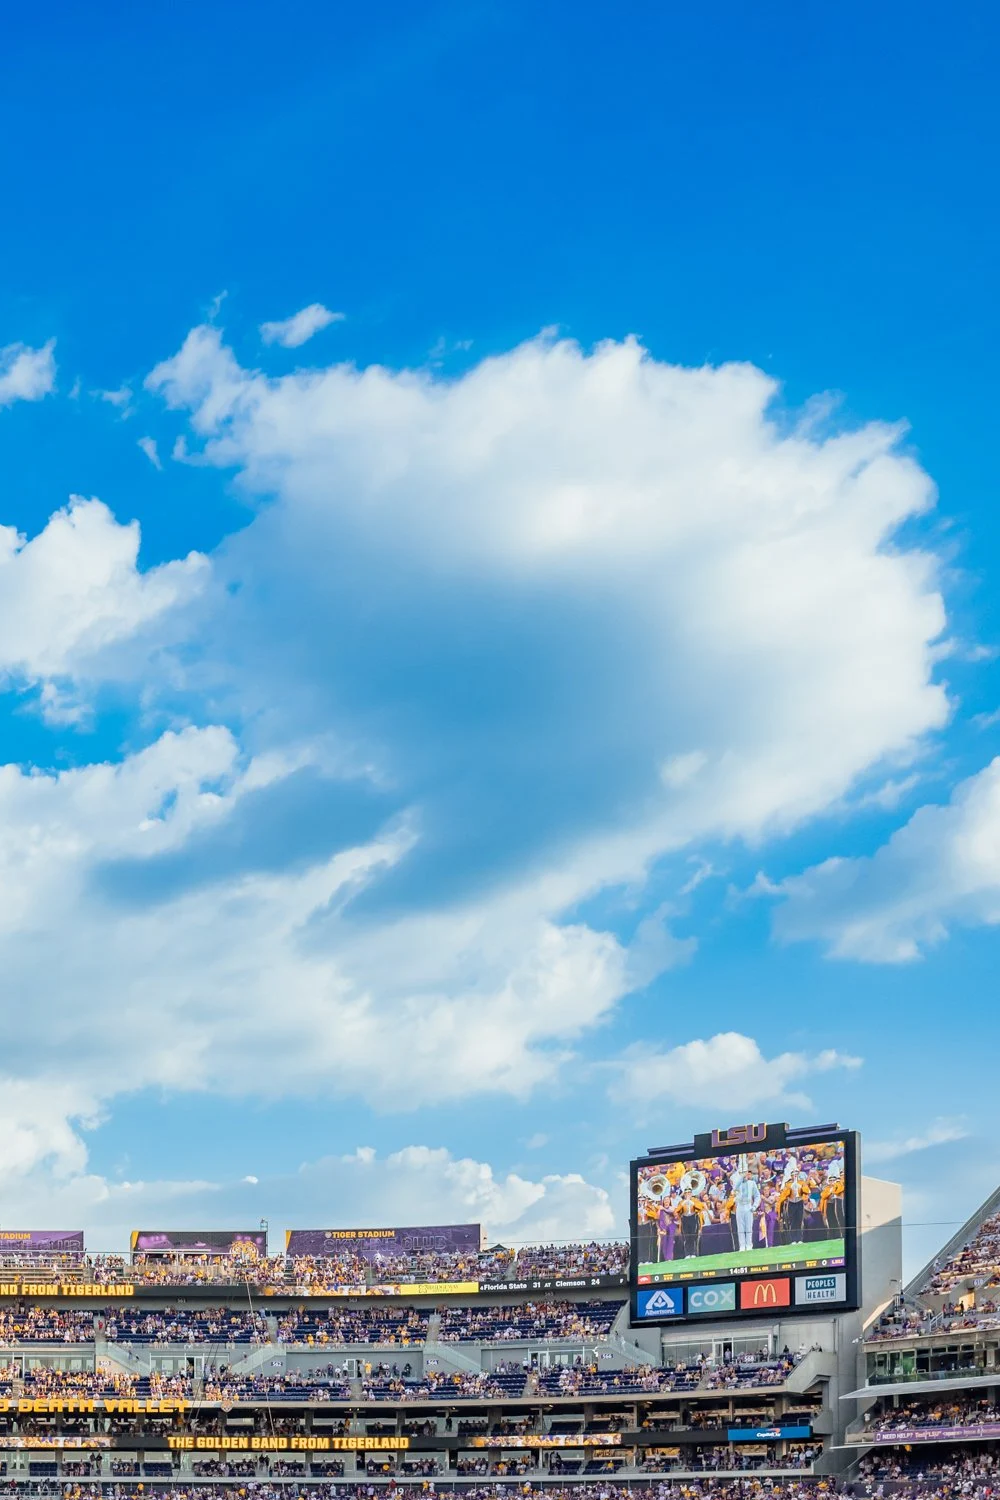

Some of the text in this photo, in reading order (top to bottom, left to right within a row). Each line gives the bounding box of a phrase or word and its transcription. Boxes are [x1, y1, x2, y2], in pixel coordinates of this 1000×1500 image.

[711, 1123, 767, 1147] LSU
[324, 1236, 447, 1252] SKYLINE CLUB
[807, 1278, 834, 1288] PEOPLES
[21, 1285, 57, 1296] FROM
[61, 1285, 134, 1296] TIGERLAND
[808, 1290, 834, 1299] HEALTH
[691, 1290, 733, 1307] COX
[645, 1308, 675, 1316] Albertsons
[18, 1399, 94, 1413] DEATH
[104, 1399, 189, 1413] VALLEY
[168, 1437, 409, 1449] THE GOLDEN BAND FROM TIGERLAND
[395, 1487, 405, 1496] 19
